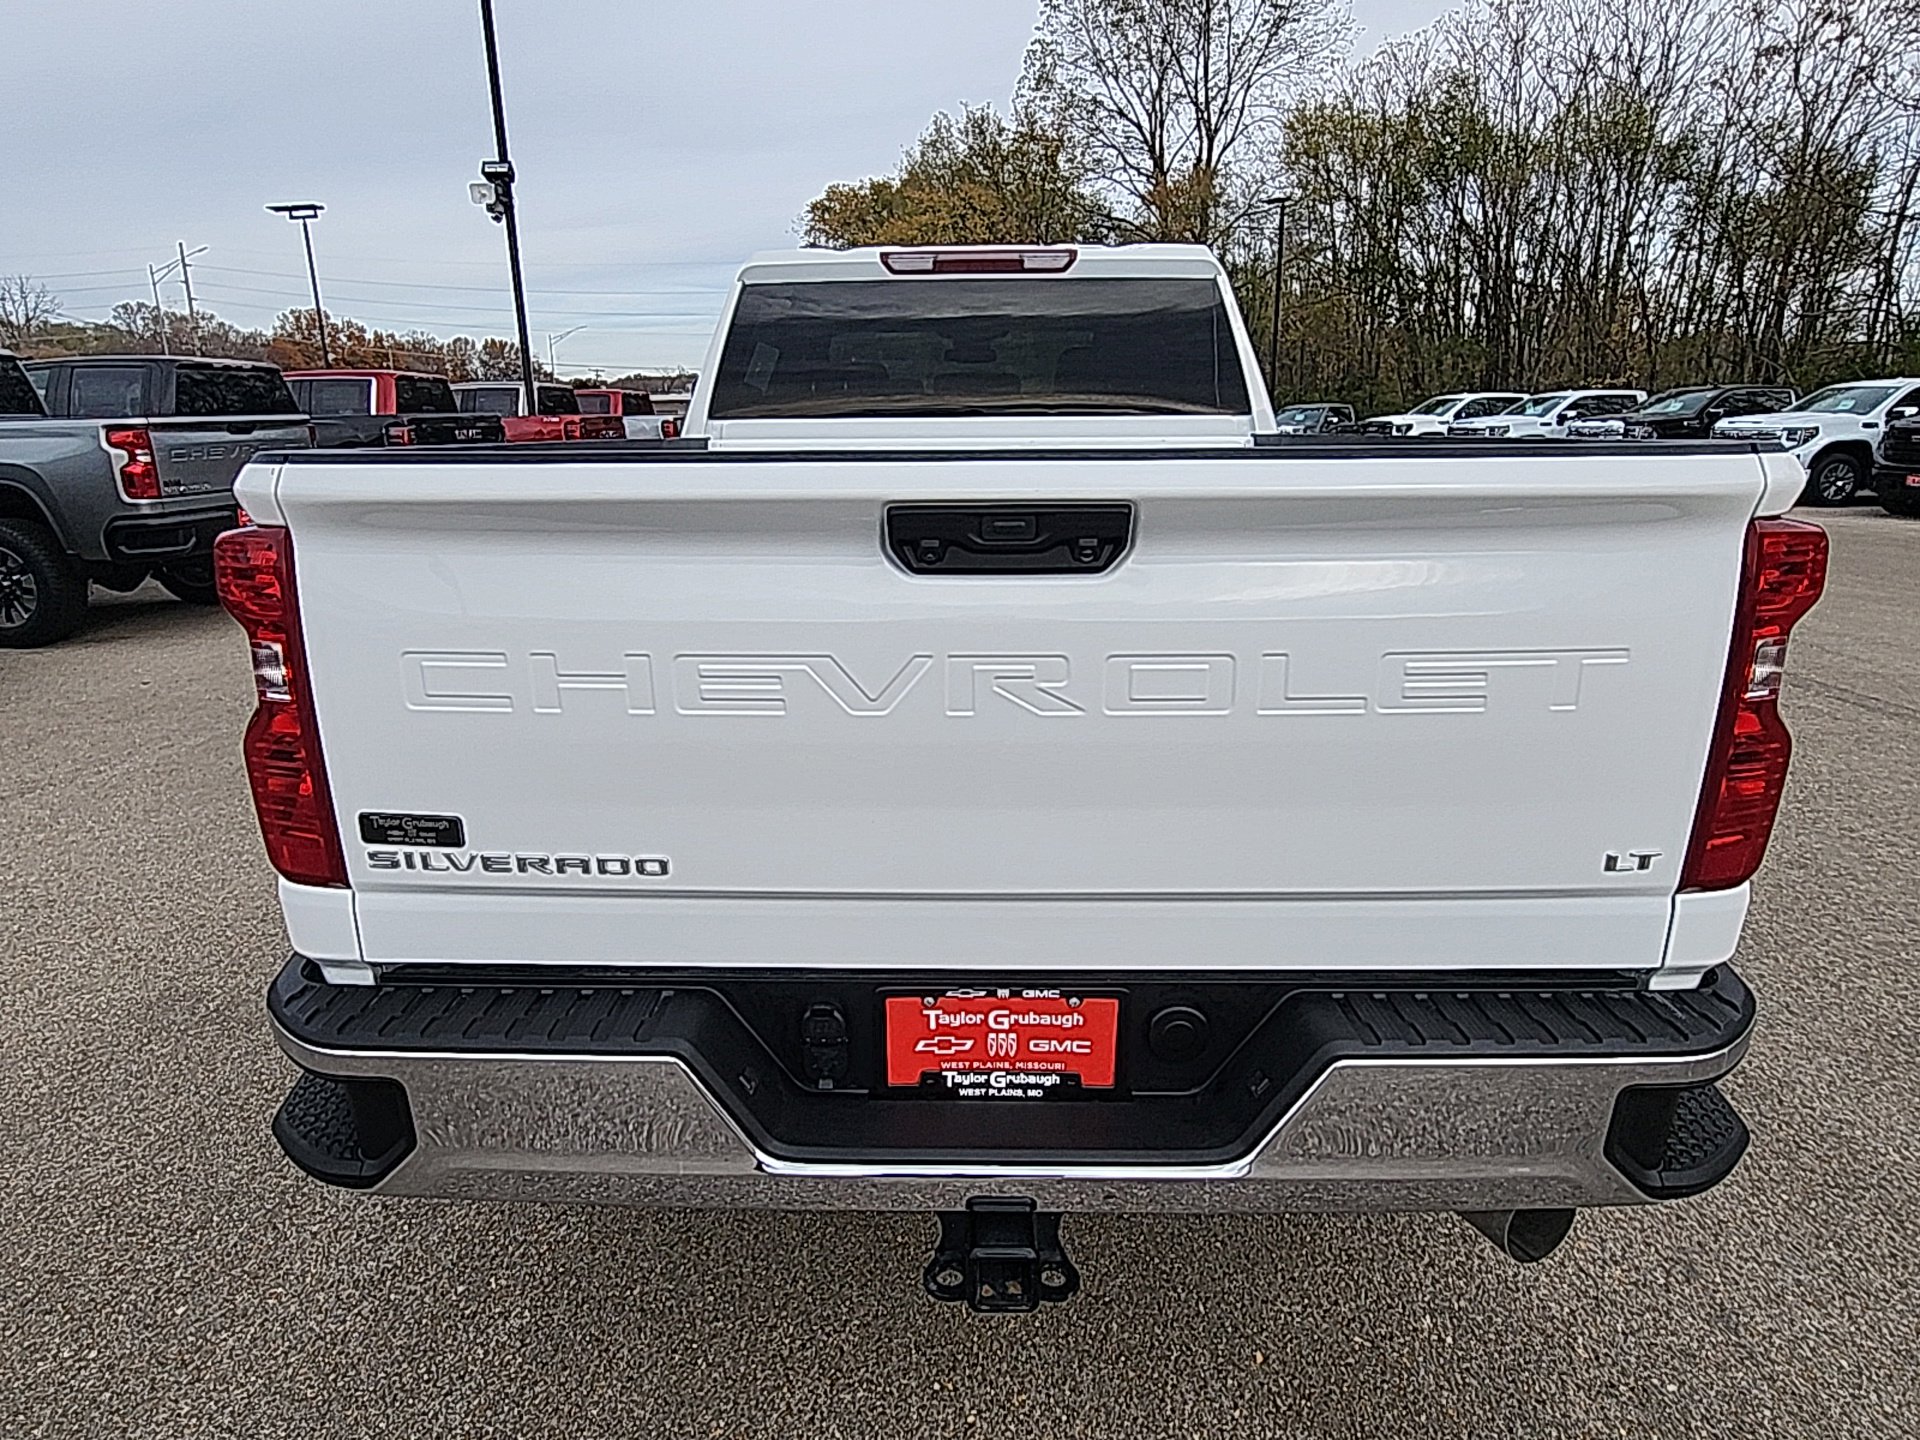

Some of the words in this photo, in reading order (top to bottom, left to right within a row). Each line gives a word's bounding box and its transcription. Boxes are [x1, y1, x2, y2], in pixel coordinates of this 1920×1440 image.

[401, 648, 1631, 718] CHEVROLET
[366, 850, 671, 876] SILVERADO
[1603, 850, 1663, 873] LT
[1022, 989, 1060, 998] GMC
[922, 1010, 984, 1029] Taylor
[988, 1010, 1083, 1029] Grubaugh
[1029, 1040, 1092, 1053] GMC
[940, 1061, 970, 1070] WEST
[1015, 1061, 1065, 1071] MISSOURI
[942, 1071, 988, 1088] Taylor
[989, 1071, 1061, 1088] Grubaugh
[958, 1088, 986, 1097] WEST
[988, 1088, 1026, 1098] PLAINS,
[1027, 1089, 1043, 1097] MO
